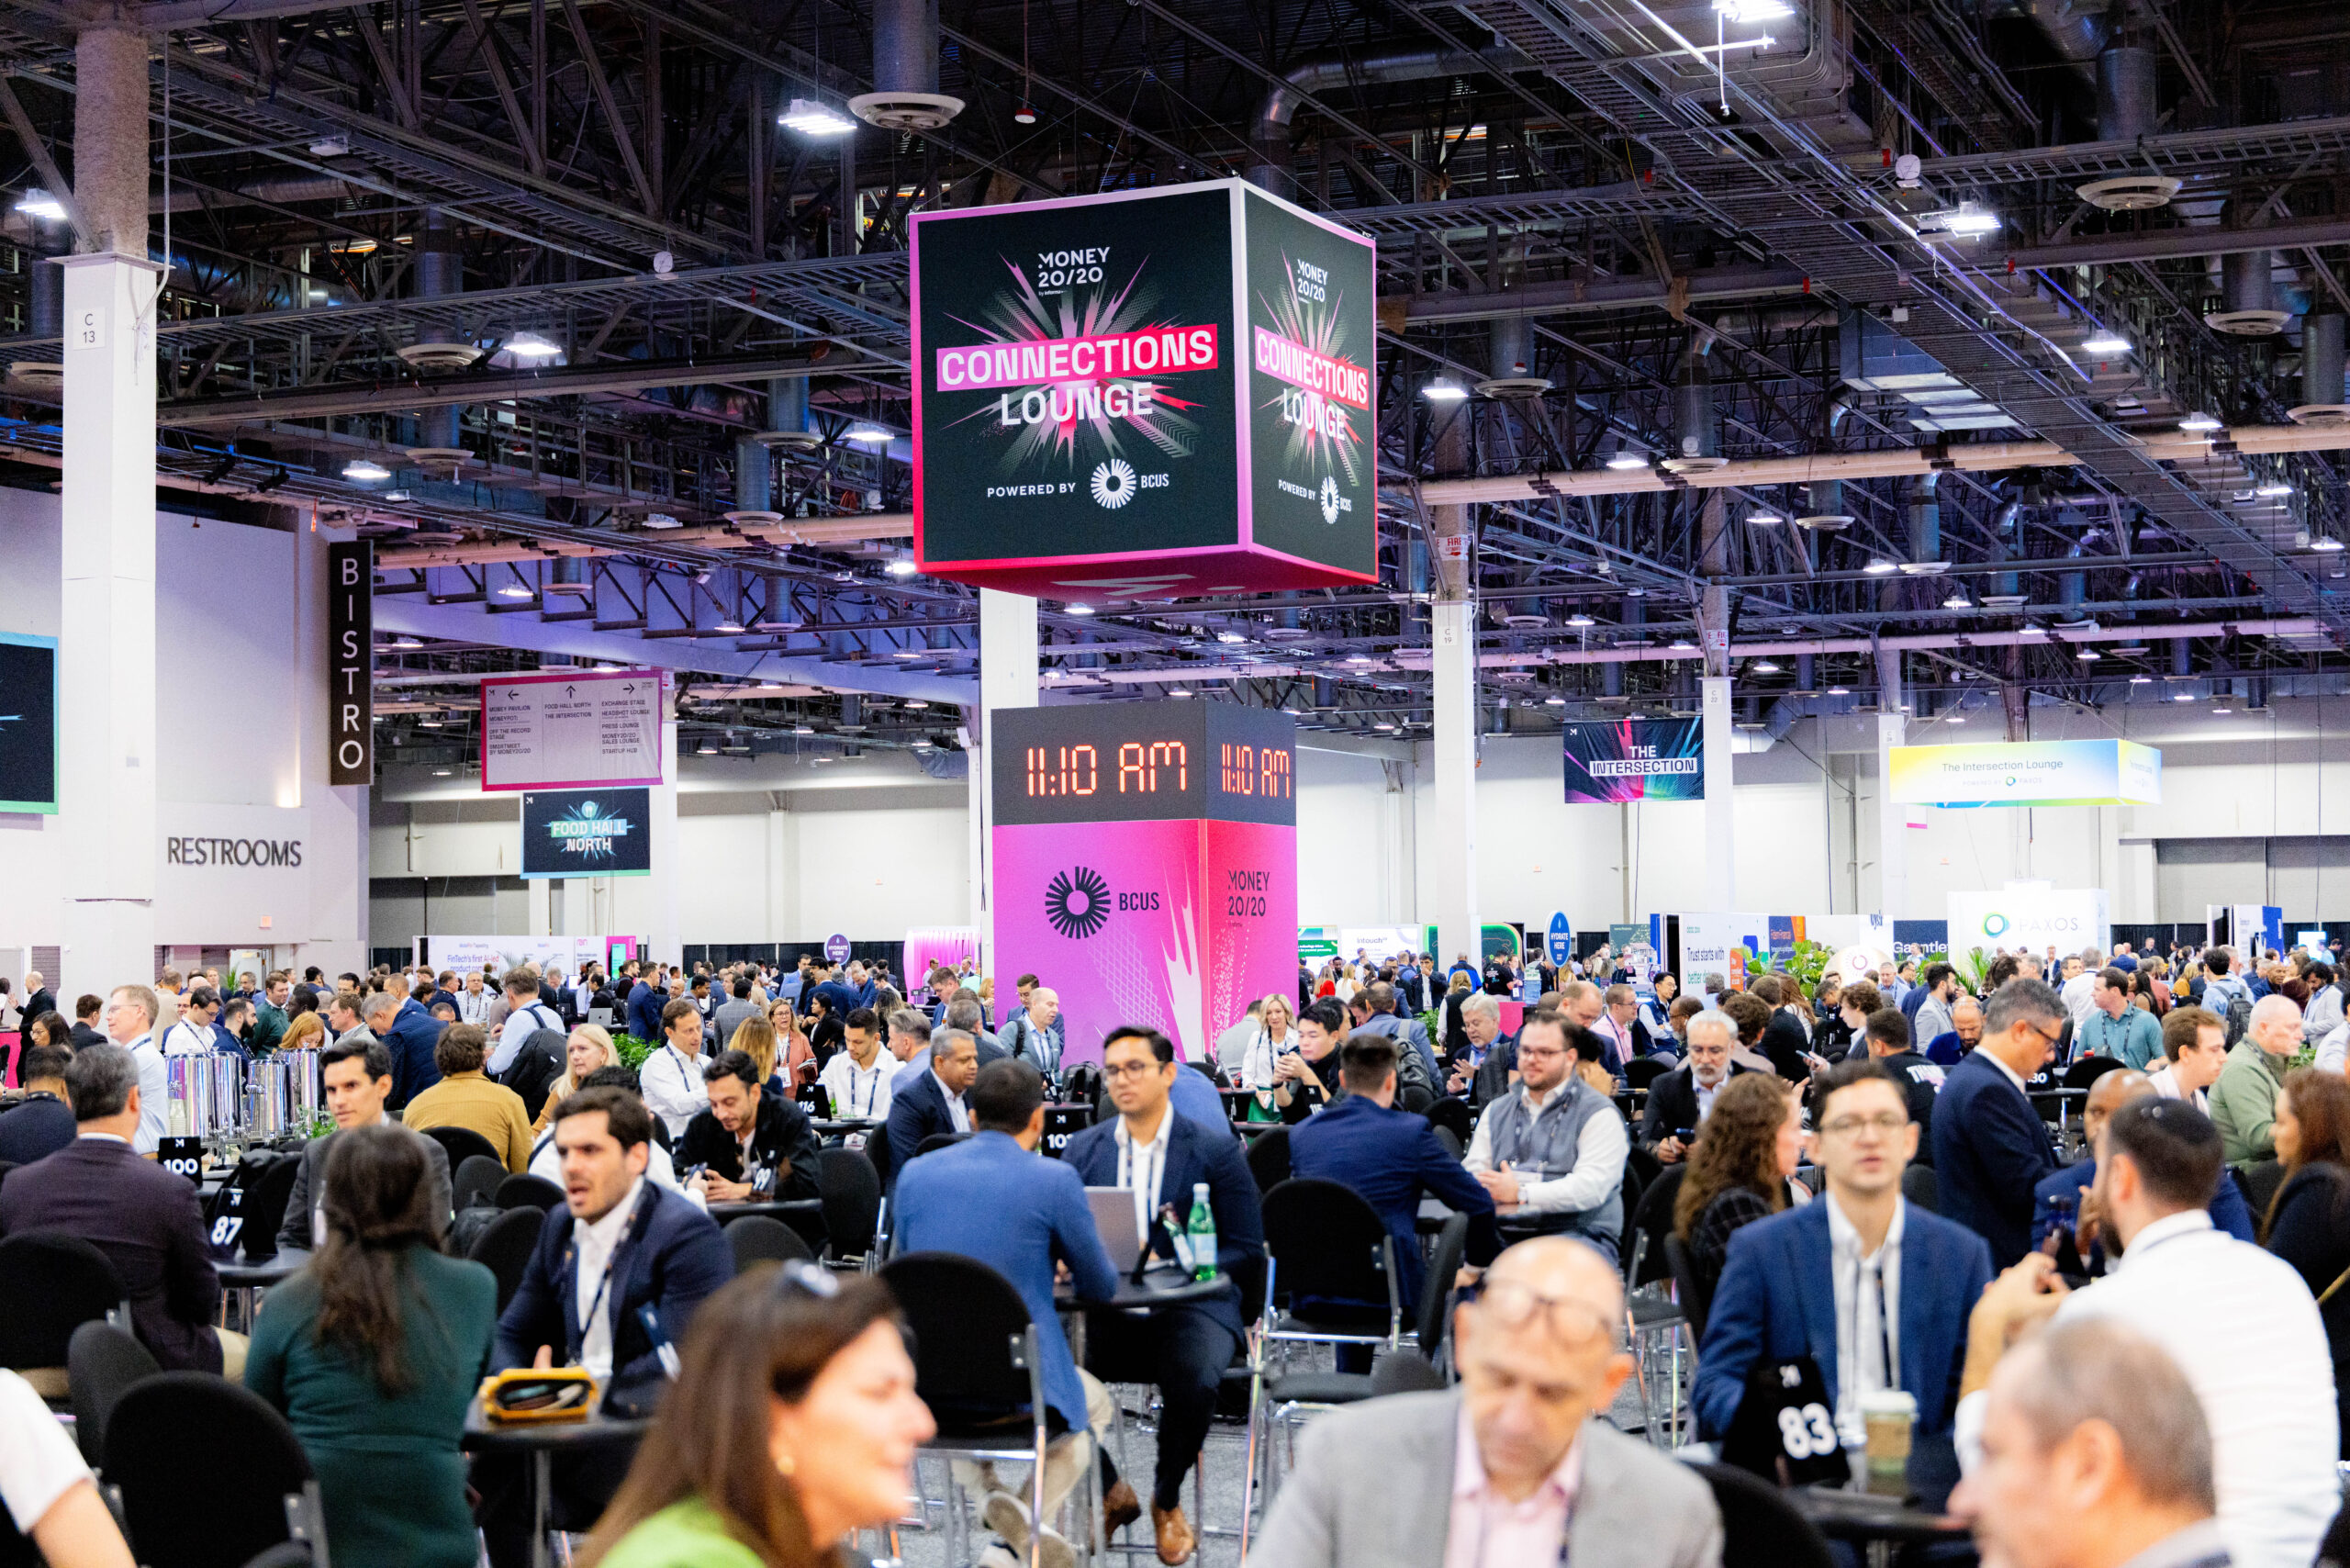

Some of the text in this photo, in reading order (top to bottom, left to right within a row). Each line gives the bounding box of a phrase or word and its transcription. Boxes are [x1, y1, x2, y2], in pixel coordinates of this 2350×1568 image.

[1038, 246, 1110, 269] MONEY
[1038, 266, 1103, 287] 20/20
[1297, 258, 1327, 286] MONEY
[1297, 277, 1326, 303] 20/20
[84, 313, 94, 326] C
[83, 330, 95, 343] 13
[941, 330, 1214, 386] CONNECTIONS
[1257, 333, 1368, 404] CONNECTIONS
[1002, 382, 1153, 426] LOUNGE
[1282, 387, 1346, 441] LOUNGE
[987, 482, 1077, 498] POWERED BY
[1141, 473, 1169, 489] BCUS
[1278, 478, 1316, 500] POWERED BY
[339, 557, 364, 769] BISTRO
[1628, 745, 1656, 758] THE
[1027, 741, 1187, 797] 11:10 AM
[1260, 748, 1290, 799] AM
[1593, 759, 1695, 774] INTERSECTION
[1942, 760, 2064, 772] The Intersection Lounge
[553, 821, 626, 836] FOOD HALL
[168, 836, 302, 868] RESTROOMS
[566, 837, 612, 852] NORTH
[1227, 869, 1270, 891] MONEY
[1118, 891, 1159, 912] BCUS
[1228, 896, 1266, 917] 20/20
[2020, 917, 2078, 933] PAXOS
[1550, 932, 1569, 941] HYDRATE
[1687, 946, 1725, 962] Trust starts with
[1893, 941, 1949, 954] Gantle
[447, 955, 471, 963] FinTech's
[472, 955, 482, 963] first
[450, 965, 470, 973] product
[2027, 1072, 2048, 1084] 30
[1046, 1134, 1074, 1149] 10
[163, 1158, 198, 1175] 100
[753, 1168, 772, 1191] 99
[210, 1215, 244, 1246] 87
[1777, 1402, 1838, 1460] 83
